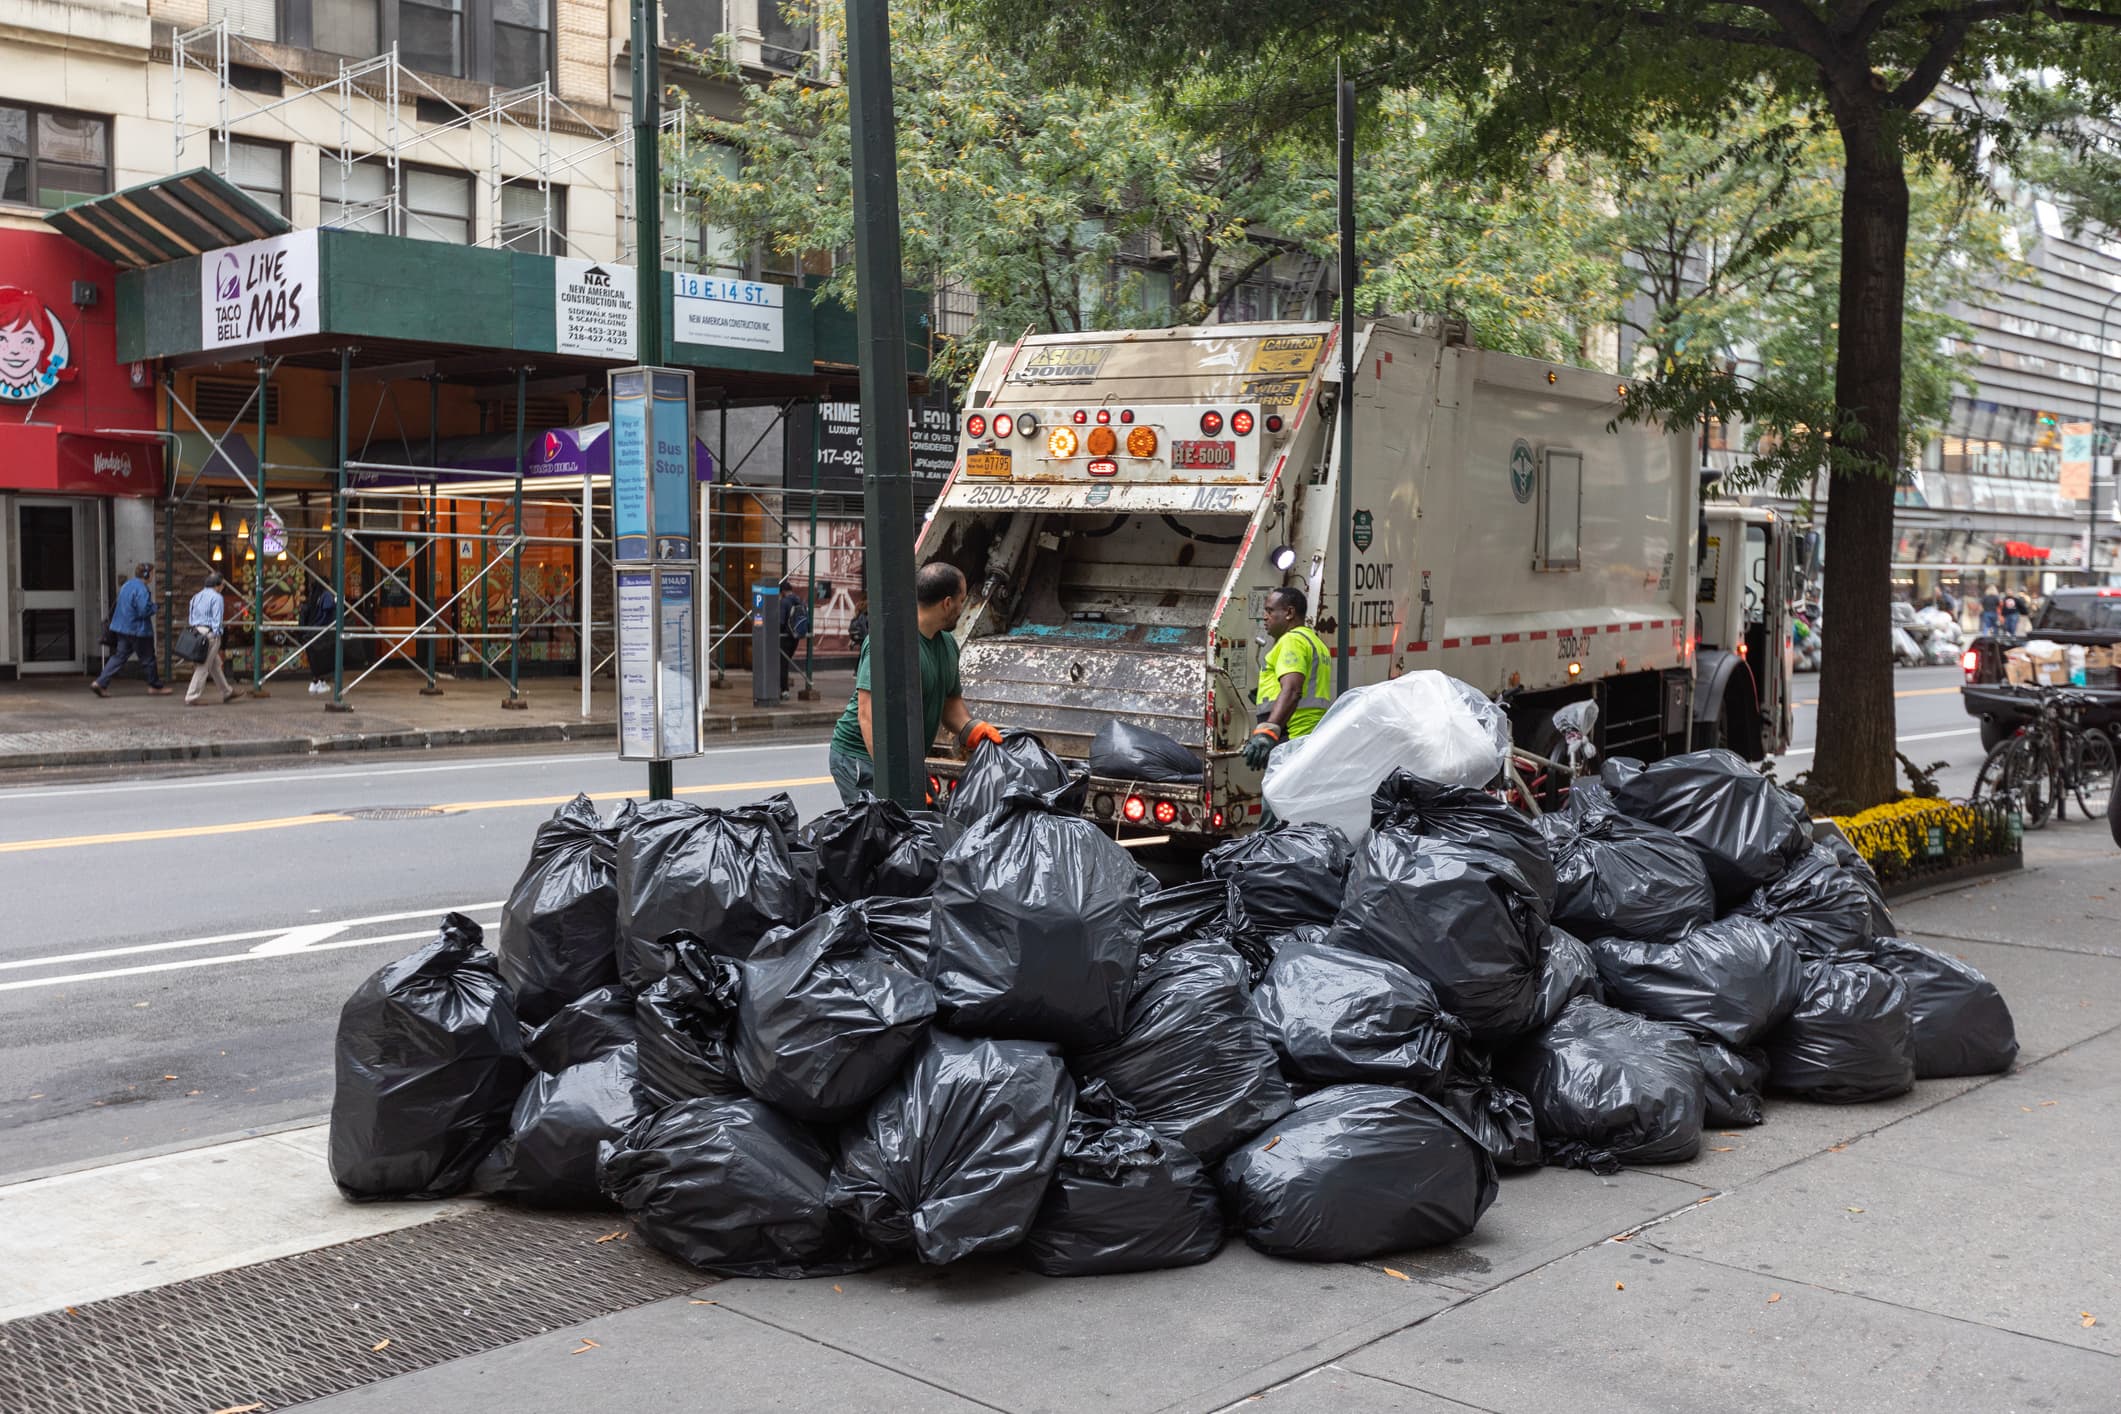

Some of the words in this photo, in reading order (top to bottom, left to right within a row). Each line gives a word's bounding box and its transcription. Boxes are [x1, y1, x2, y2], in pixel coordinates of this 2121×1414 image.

[584, 274, 611, 288] NAC
[569, 284, 586, 295] NEW
[587, 287, 625, 299] AMERICAN
[680, 274, 698, 296] 18
[705, 281, 717, 298] E.
[722, 280, 738, 301] 14
[745, 283, 769, 305] ST.
[561, 293, 618, 308] CONSTRUCTION
[619, 301, 634, 311] INC.
[215, 304, 242, 324] TACO
[568, 308, 607, 318] SIDEWALK
[608, 312, 628, 321] SHED
[575, 316, 627, 328] SCAFFOLDING
[688, 314, 701, 324] NEW
[701, 315, 729, 328] AMERICAN
[728, 319, 762, 331] CONSTRUCTION
[217, 322, 242, 342] BELL
[568, 324, 628, 338] 347-453-3738
[568, 332, 628, 346] 718-427-4323
[1265, 337, 1318, 350] CAUTION
[1049, 348, 1105, 366] SLOW
[1254, 383, 1293, 394] WIDE
[923, 410, 951, 431] FOR
[828, 425, 860, 436] LUXURY
[930, 433, 951, 442] OVER
[658, 441, 682, 456] Bus
[1173, 447, 1231, 465] HE-5000
[94, 451, 121, 476] Wendy's
[529, 463, 554, 474] TACO
[554, 462, 578, 473] BELL
[655, 460, 685, 477] Stop
[967, 486, 1051, 505] 25DD-872
[462, 543, 472, 554] A
[661, 576, 687, 585] M14A/D
[1355, 563, 1394, 590] DON'T
[756, 594, 763, 608] P
[1349, 600, 1395, 628] LITTER
